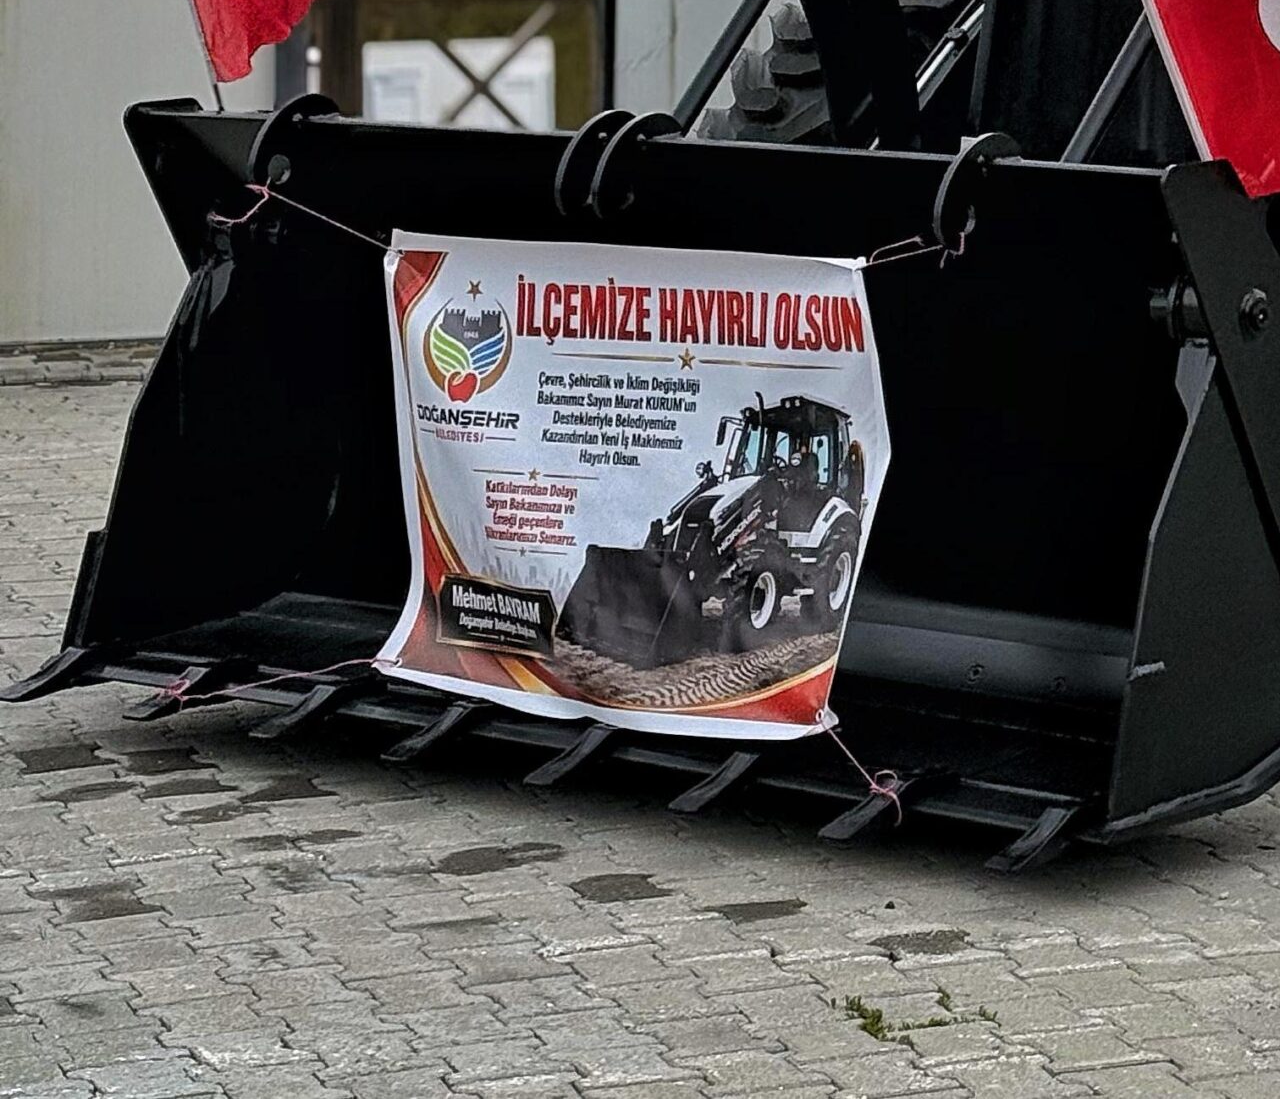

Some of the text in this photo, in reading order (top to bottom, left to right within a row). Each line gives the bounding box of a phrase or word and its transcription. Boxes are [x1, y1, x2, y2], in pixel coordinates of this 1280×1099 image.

[516, 274, 865, 352] İLÇEMİZE HAYIRLI OLSUN
[538, 372, 701, 396] Çevre, Şehircilik ve İklim Değişikliği
[537, 391, 697, 413] Bakanımız Sayın Murat KURUM'un
[552, 411, 677, 432] Destekleriyle Belediyemize
[541, 429, 684, 450] Kazandırılan Yeni İş Makinemiz
[579, 449, 641, 467] Hayırlı Olsun.
[564, 503, 576, 514] ve
[452, 585, 541, 624] Mehmet BAYRAM
